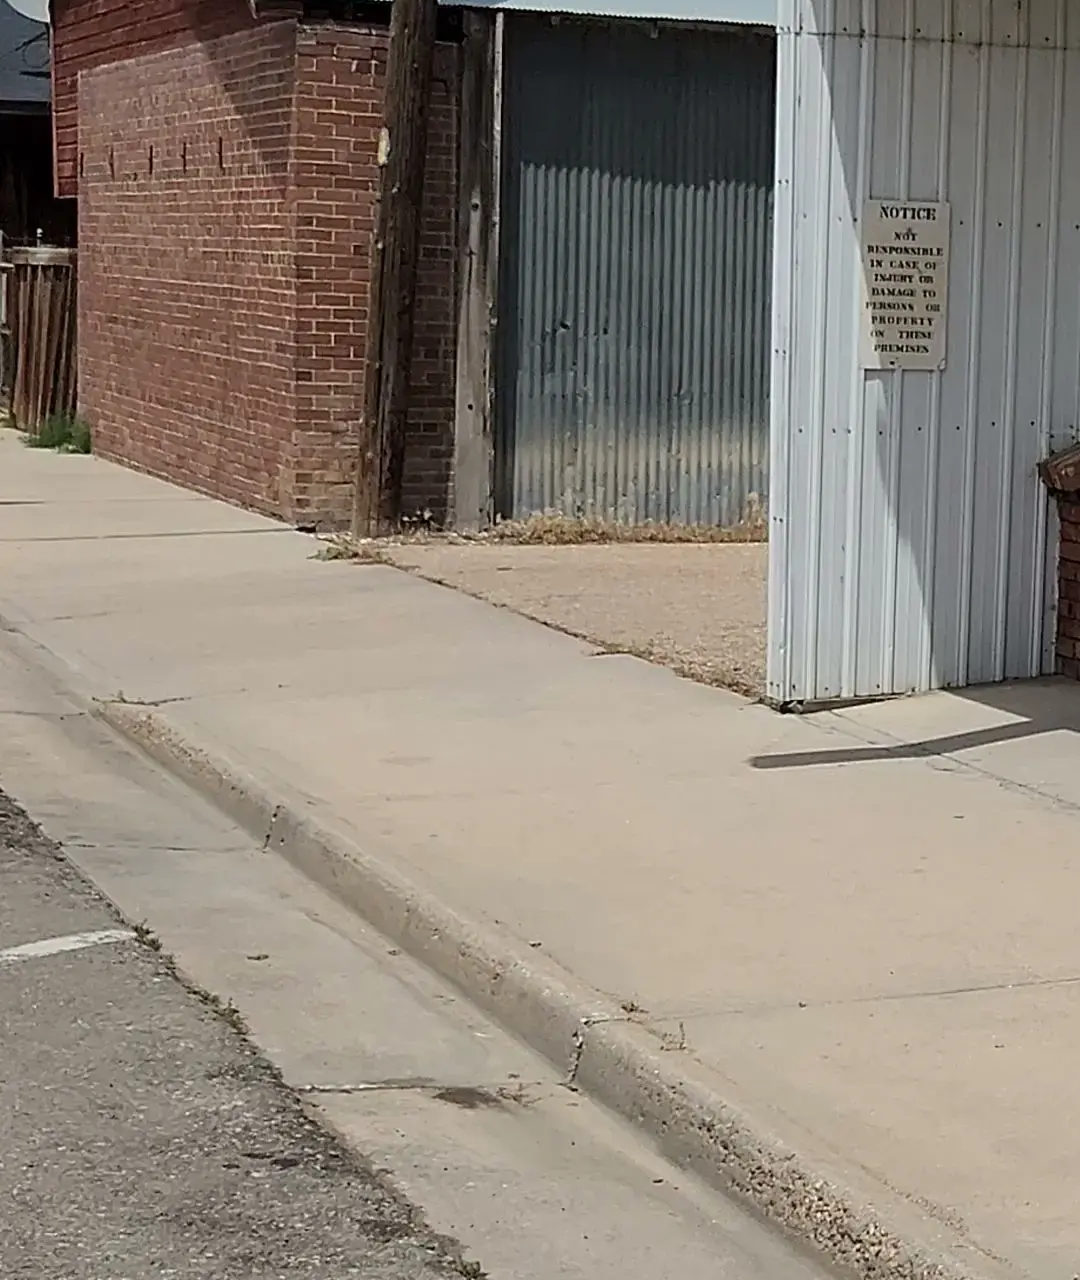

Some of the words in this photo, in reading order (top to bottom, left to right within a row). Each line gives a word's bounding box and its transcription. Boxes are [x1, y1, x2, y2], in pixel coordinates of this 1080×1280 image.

[880, 206, 936, 221] NOTICE
[894, 231, 918, 241] NOT
[867, 245, 944, 257] RESPONSIBLE
[870, 259, 883, 268] IN
[889, 260, 919, 269] CASE
[924, 261, 936, 271] OF
[874, 273, 914, 284] INJURY
[919, 275, 934, 284] OR
[872, 287, 917, 297] DAMAGE
[923, 290, 937, 298] TO
[866, 301, 915, 312] PERSONS
[925, 303, 940, 313] OR
[872, 315, 934, 327] PROPERTY
[870, 330, 885, 338] ON
[898, 330, 934, 339] THESE
[874, 343, 930, 354] PREMISES
